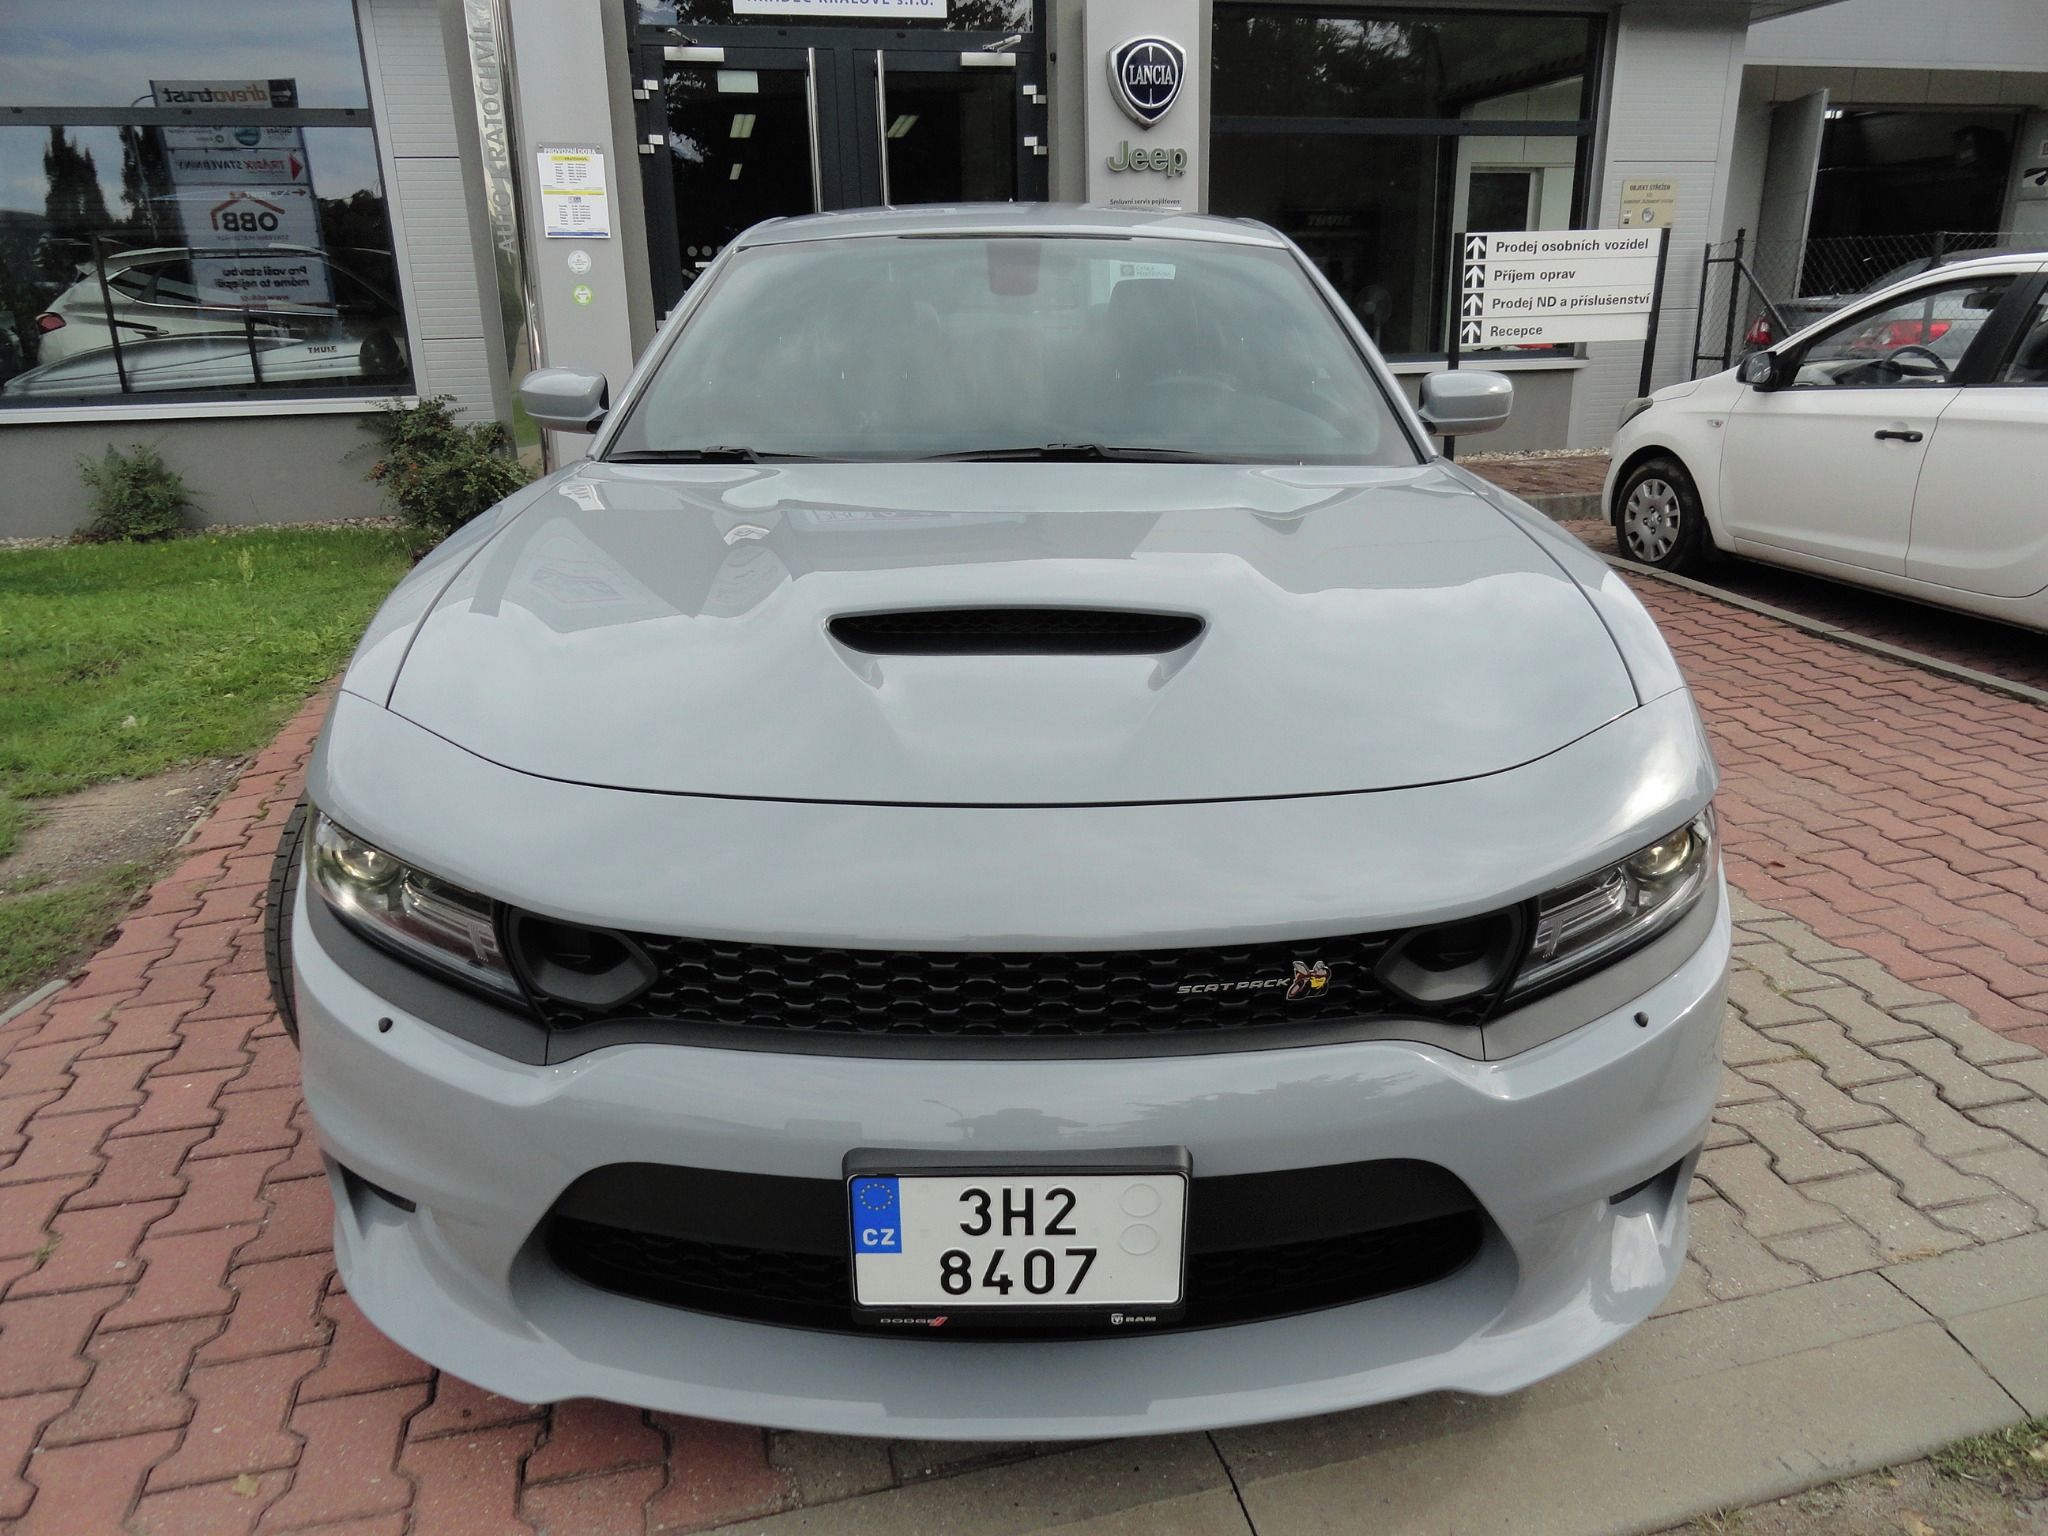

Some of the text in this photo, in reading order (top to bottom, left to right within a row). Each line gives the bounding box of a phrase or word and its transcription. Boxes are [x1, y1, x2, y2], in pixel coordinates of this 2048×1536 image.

[1128, 65, 1174, 85] LANCIA
[1106, 140, 1188, 177] Jeep
[1496, 238, 1649, 255] Prodej osobních vozidel
[1493, 269, 1576, 283] Příjem oprav
[1492, 292, 1651, 311] Prodej ND a příslušenství
[1490, 326, 1543, 338] Recepce
[1176, 978, 1291, 994] SCAT PACK
[959, 1187, 1077, 1237] 3H2
[862, 1228, 896, 1247] CZ
[939, 1248, 1098, 1296] 8407
